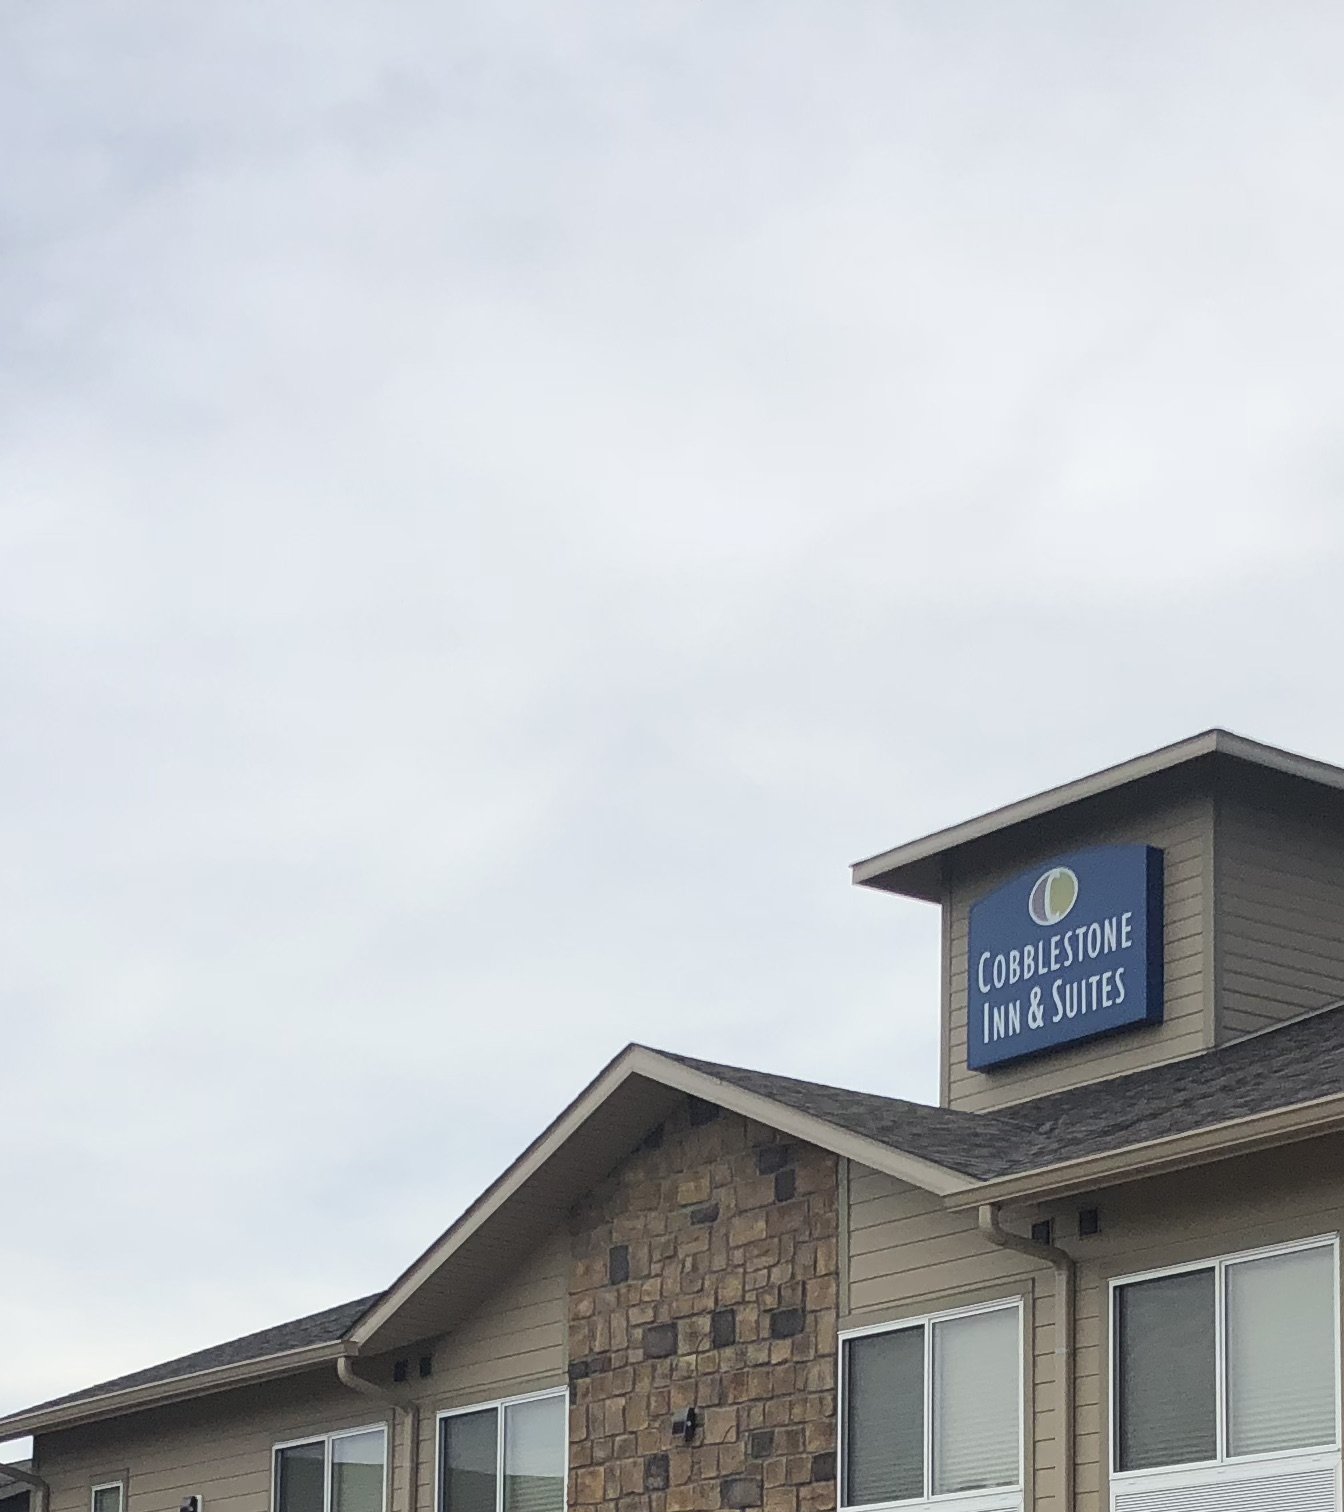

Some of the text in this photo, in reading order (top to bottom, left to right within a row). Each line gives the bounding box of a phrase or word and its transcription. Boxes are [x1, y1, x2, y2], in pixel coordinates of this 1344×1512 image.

[978, 911, 1133, 993] COBBLESTONE
[983, 967, 1125, 1043] INN & SUITES
